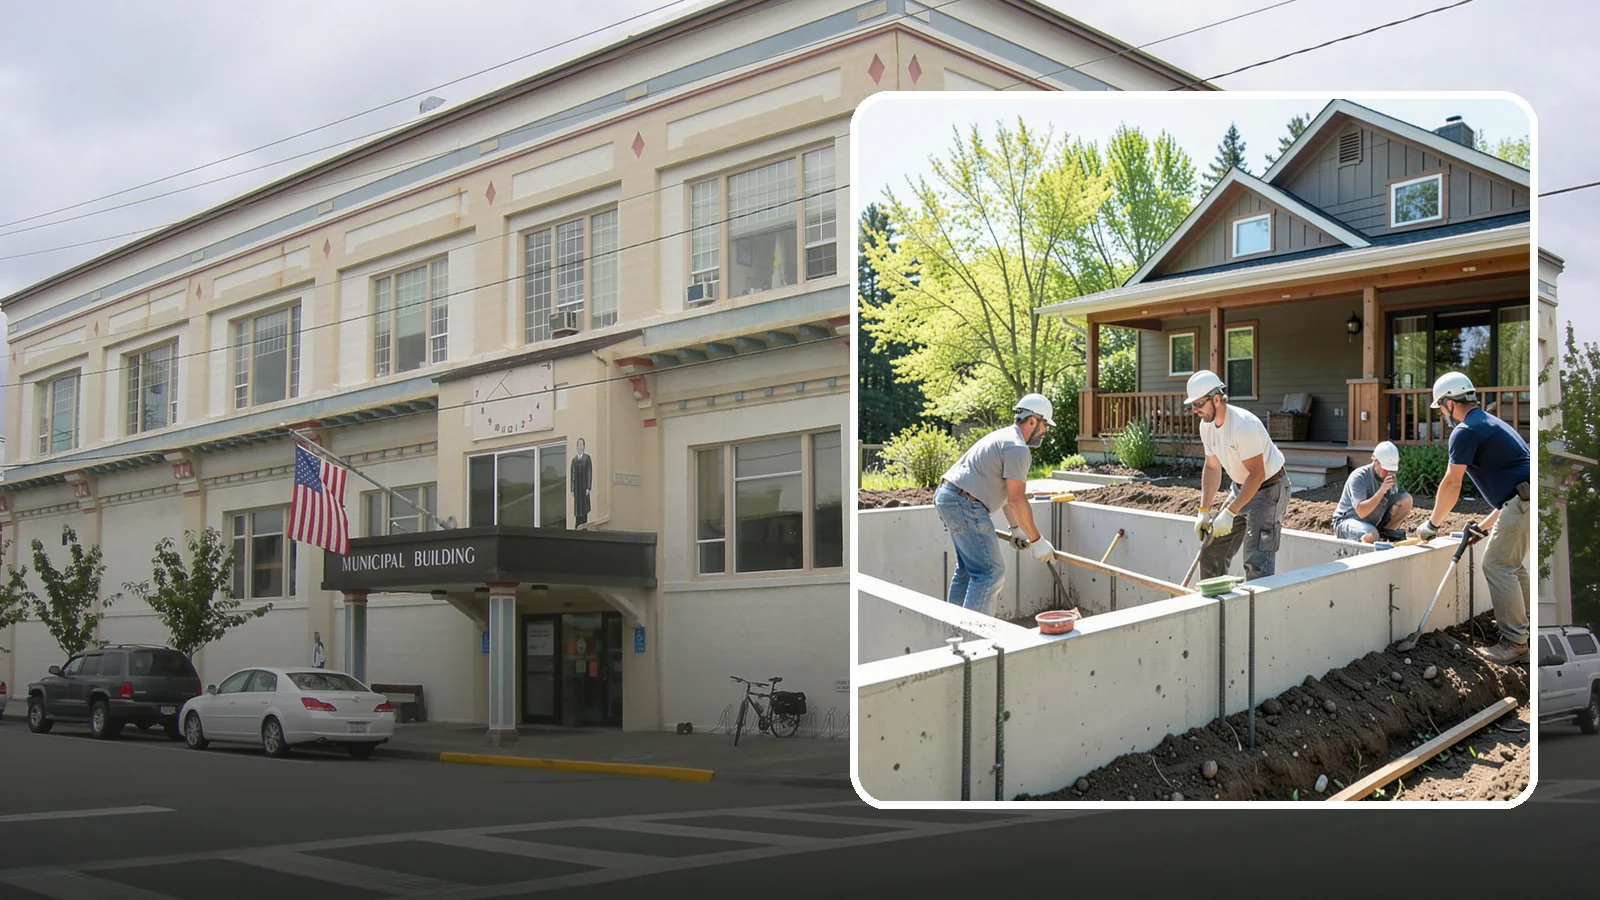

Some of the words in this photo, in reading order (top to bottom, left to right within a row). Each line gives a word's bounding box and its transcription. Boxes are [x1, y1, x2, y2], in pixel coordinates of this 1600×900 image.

[536, 402, 540, 410] 4
[481, 407, 485, 415] 8
[488, 418, 492, 426] 9
[529, 414, 533, 422] 3
[495, 423, 500, 431] 10
[521, 420, 525, 428] 2
[501, 425, 506, 433] 11
[507, 425, 513, 433] 12
[342, 552, 405, 571] MUNICIPAL
[414, 546, 475, 567] BUILDING
